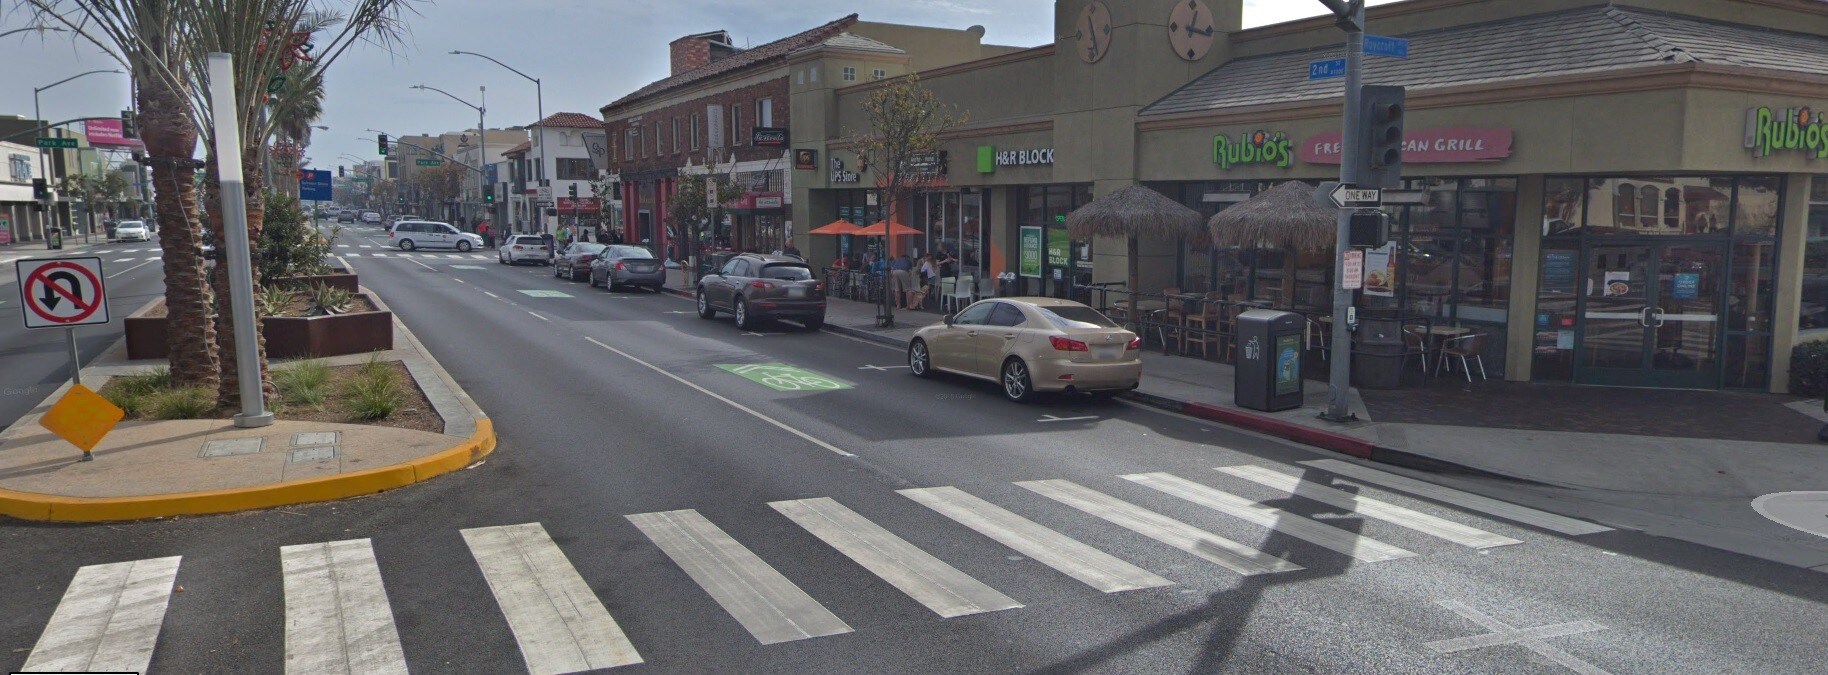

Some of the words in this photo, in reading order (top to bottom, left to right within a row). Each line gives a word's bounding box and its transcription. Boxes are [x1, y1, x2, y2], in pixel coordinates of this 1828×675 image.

[1312, 63, 1329, 75] 2nd
[1756, 106, 1828, 158] Rubio's
[1212, 131, 1290, 169] Rubio's
[1314, 142, 1342, 155] FRE
[1434, 138, 1486, 151] GRILL
[995, 151, 1017, 165] H&R
[1019, 148, 1055, 165] BLOCK
[830, 158, 841, 169] The
[830, 170, 842, 182] UPS
[842, 170, 857, 182] Store
[1345, 190, 1361, 201] ONE
[1361, 190, 1377, 200] WAY
[1048, 247, 1061, 256] H&R
[1048, 256, 1068, 266] BLOCK
